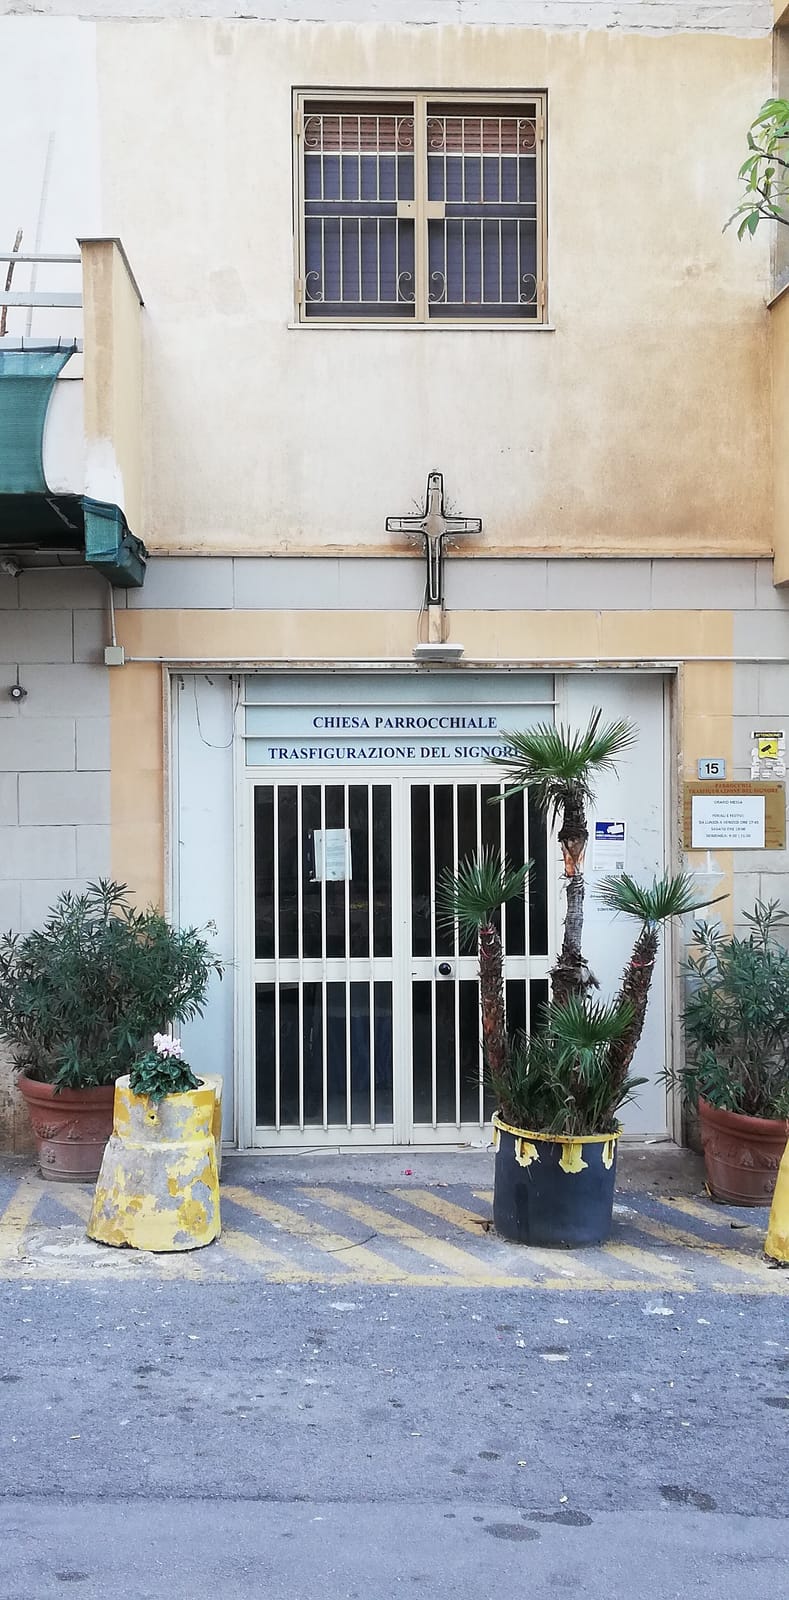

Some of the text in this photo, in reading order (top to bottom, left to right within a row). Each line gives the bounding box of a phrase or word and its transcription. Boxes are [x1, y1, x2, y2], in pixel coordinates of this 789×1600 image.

[312, 716, 498, 729] CHIESA PARROCCHIALE
[267, 746, 416, 760] TRASFIGURAZIONE
[420, 746, 450, 759] DEL
[704, 763, 719, 774] 15
